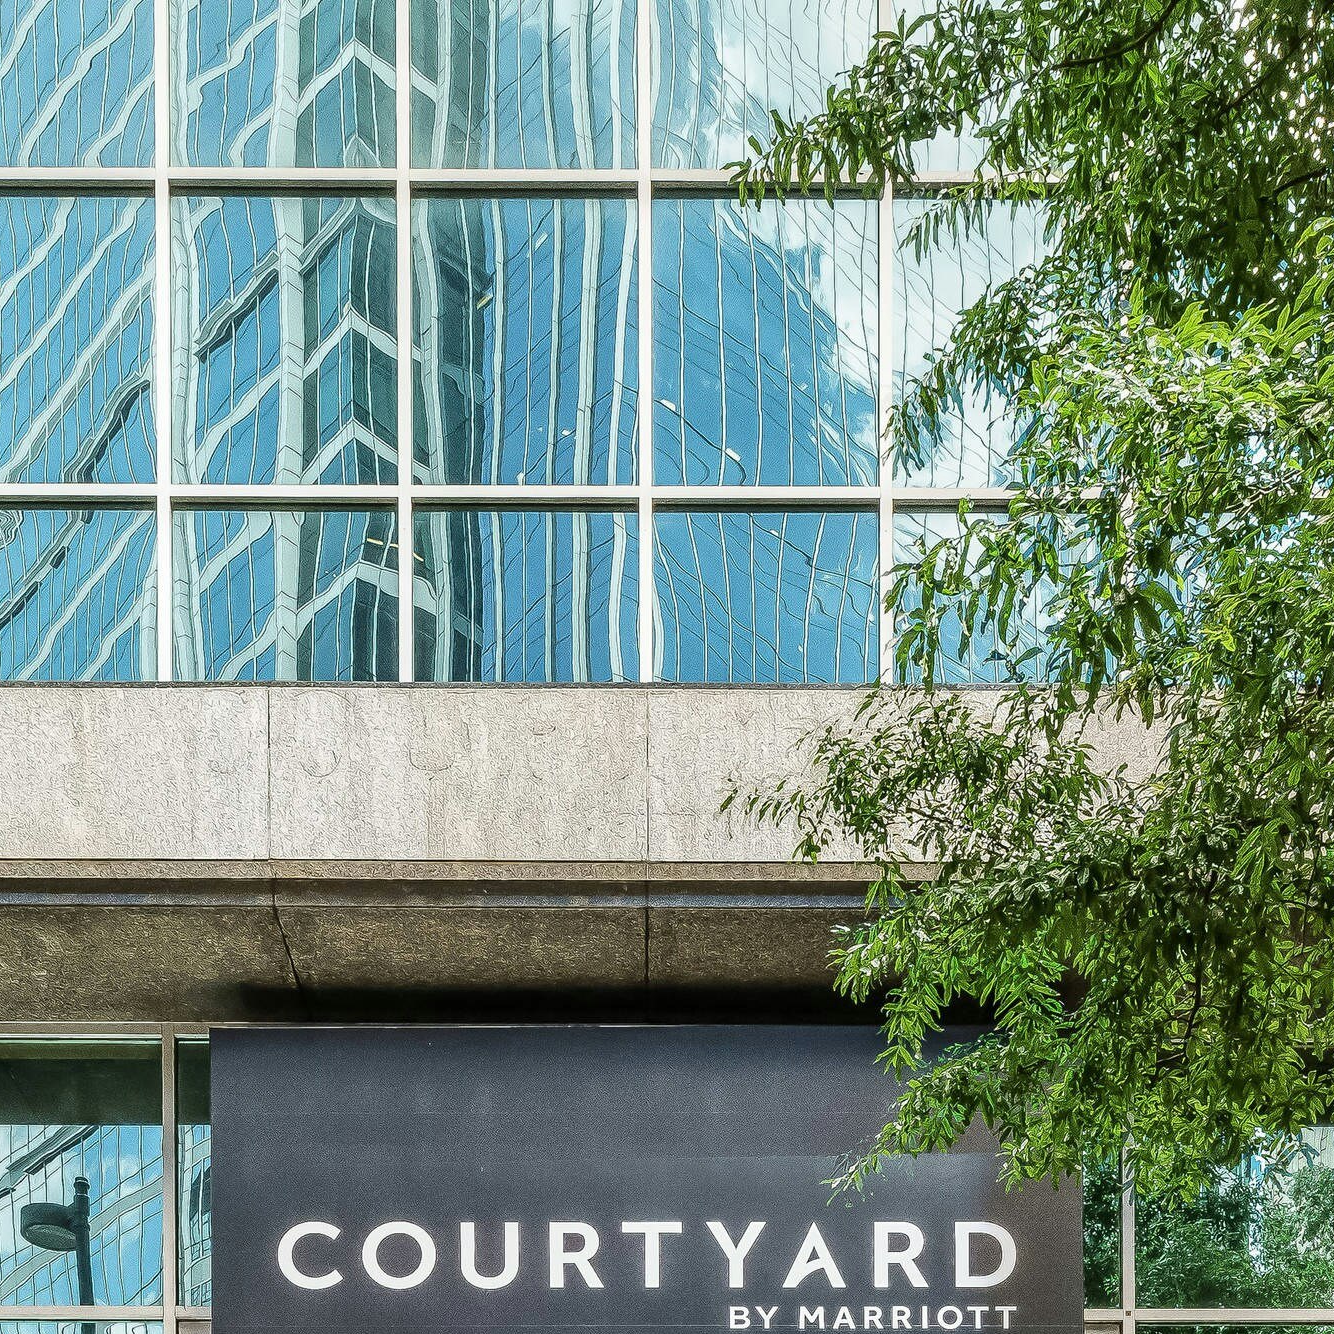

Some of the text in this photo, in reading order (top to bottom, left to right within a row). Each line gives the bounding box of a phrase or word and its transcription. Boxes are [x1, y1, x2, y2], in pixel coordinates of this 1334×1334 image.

[276, 1220, 1019, 1290] COURTYARD
[729, 1306, 1019, 1330] BY MARRIOTT
